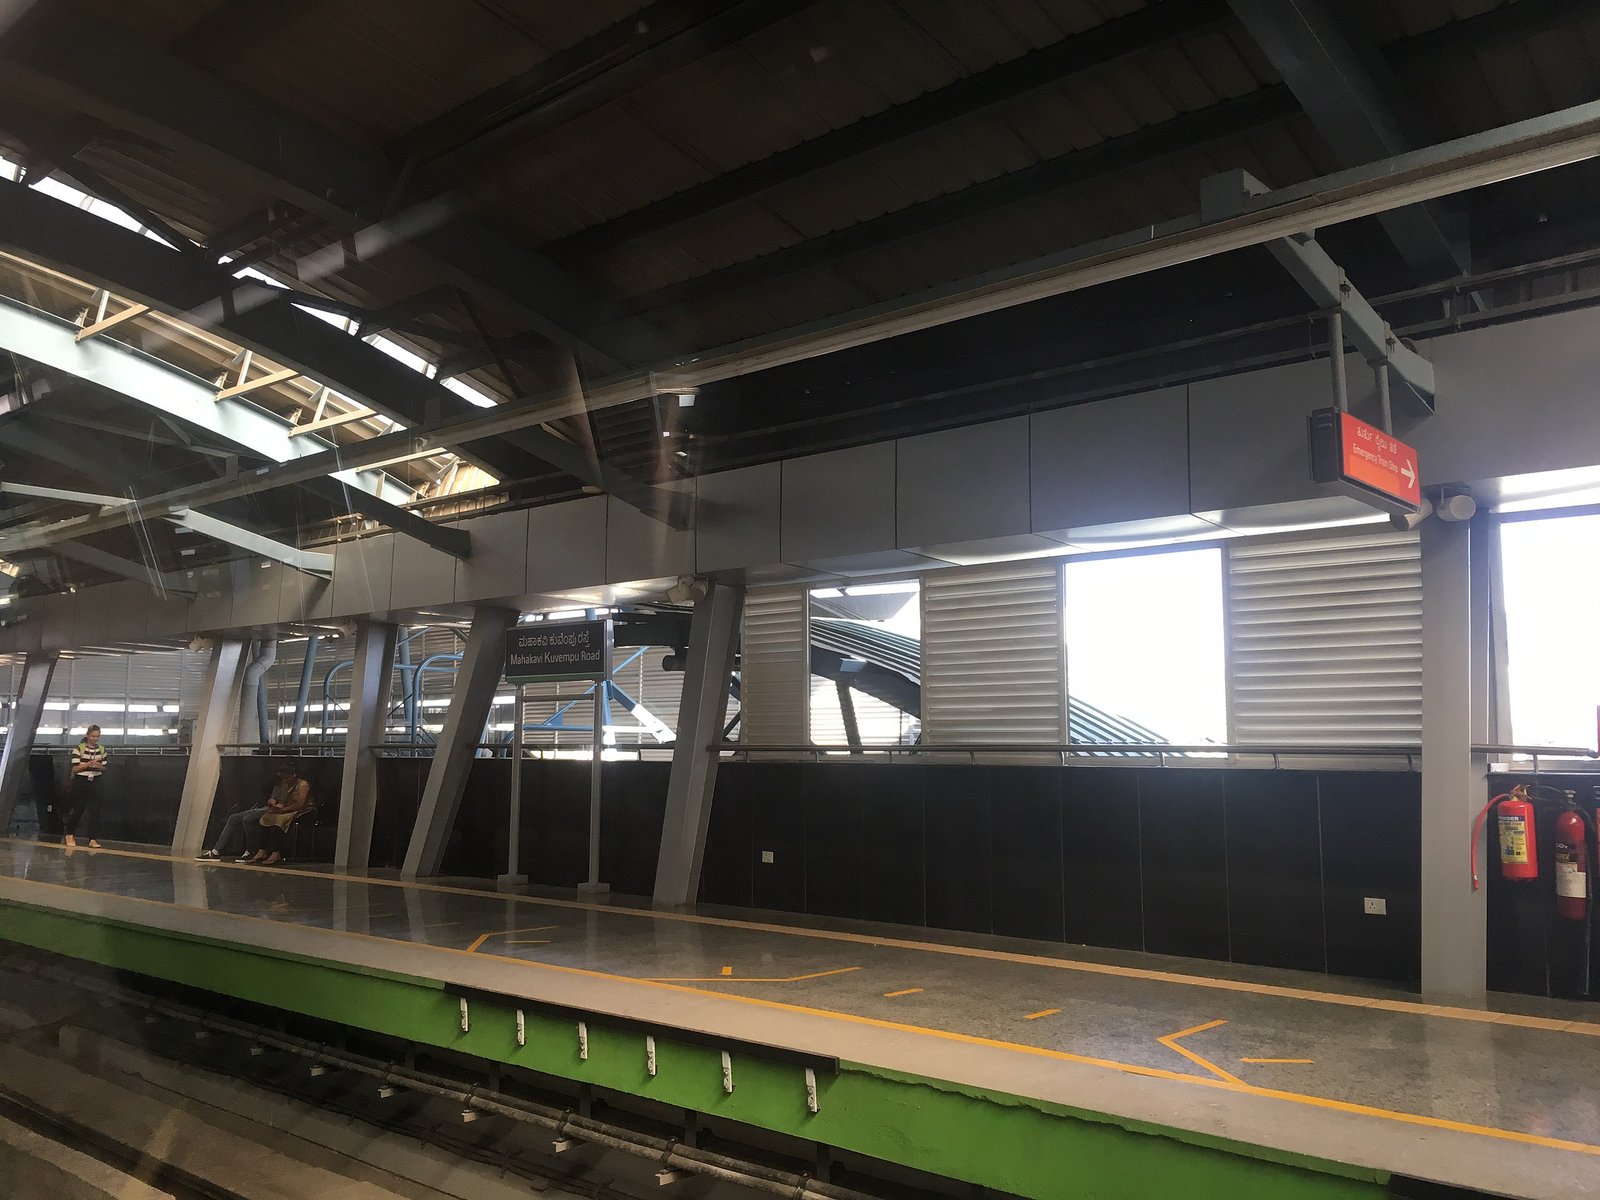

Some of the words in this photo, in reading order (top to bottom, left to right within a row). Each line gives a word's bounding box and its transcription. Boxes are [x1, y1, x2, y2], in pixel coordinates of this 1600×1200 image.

[1353, 443, 1377, 464] Emergency
[1377, 454, 1389, 468] Train
[1389, 460, 1398, 473] Stop
[518, 635, 547, 648] ಮಹಾಕವಿ
[510, 652, 543, 665] Mahakavi
[544, 651, 579, 664] Kuvempu
[581, 649, 600, 661] Road
